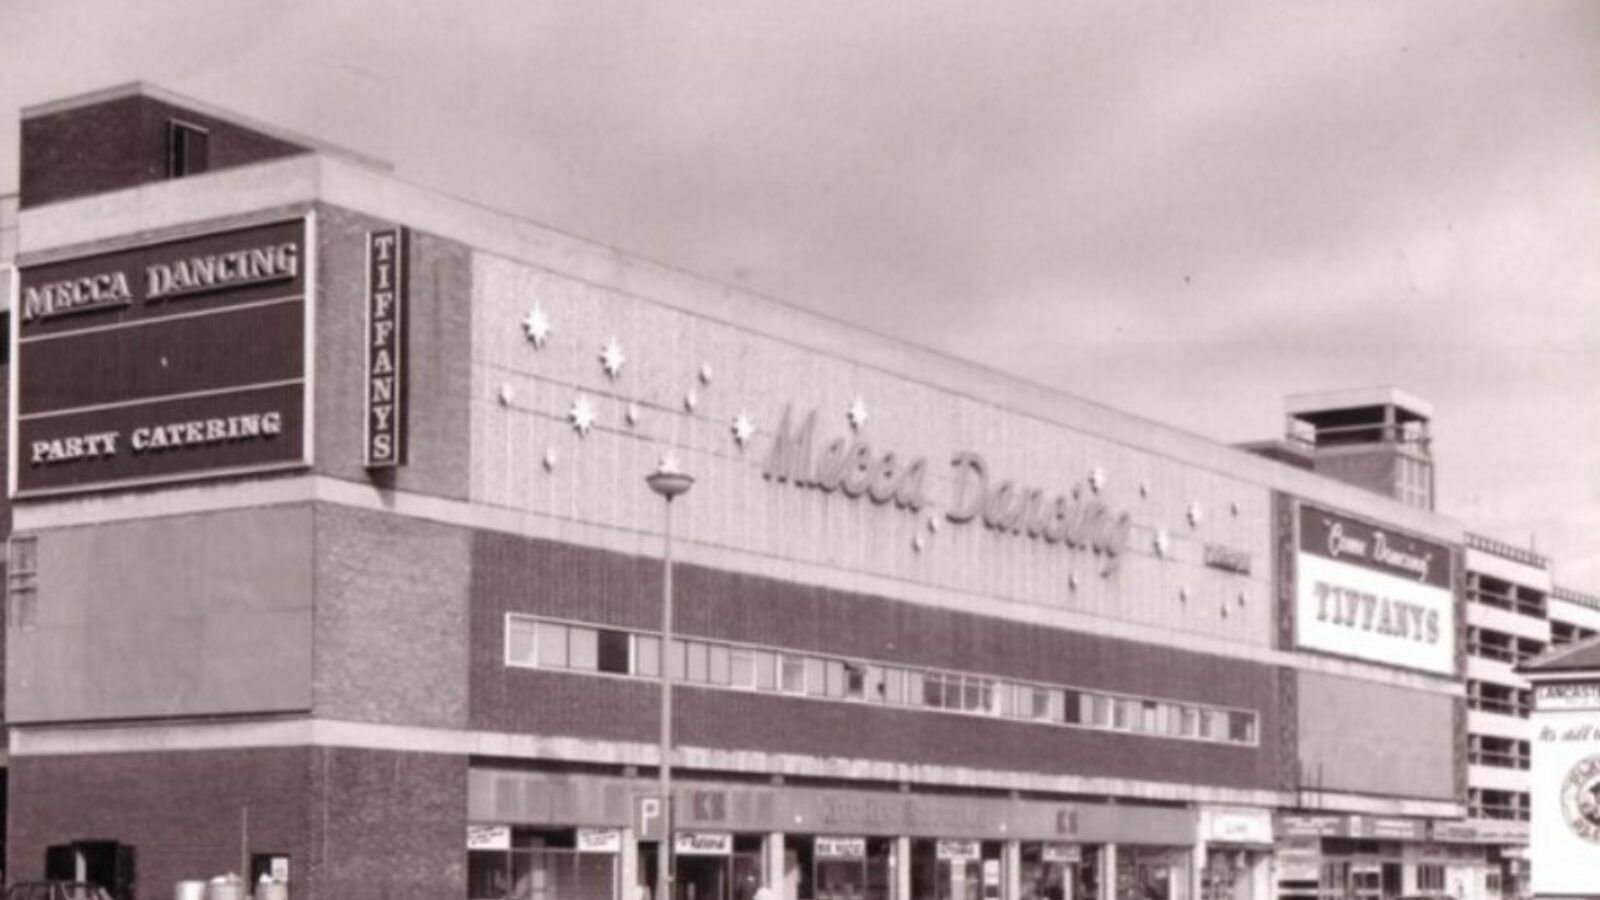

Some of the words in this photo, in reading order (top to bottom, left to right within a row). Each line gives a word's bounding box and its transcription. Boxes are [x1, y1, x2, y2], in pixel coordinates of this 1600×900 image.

[22, 271, 132, 321] MECCA
[145, 242, 298, 298] DANCING
[372, 234, 396, 460] TIFFANYS
[31, 431, 119, 464] PARTY
[131, 411, 281, 451] CATERING
[762, 403, 926, 514] Mecca
[946, 450, 1131, 579] Dancing
[1313, 579, 1440, 645] TIFFANYS
[641, 798, 660, 836] P
